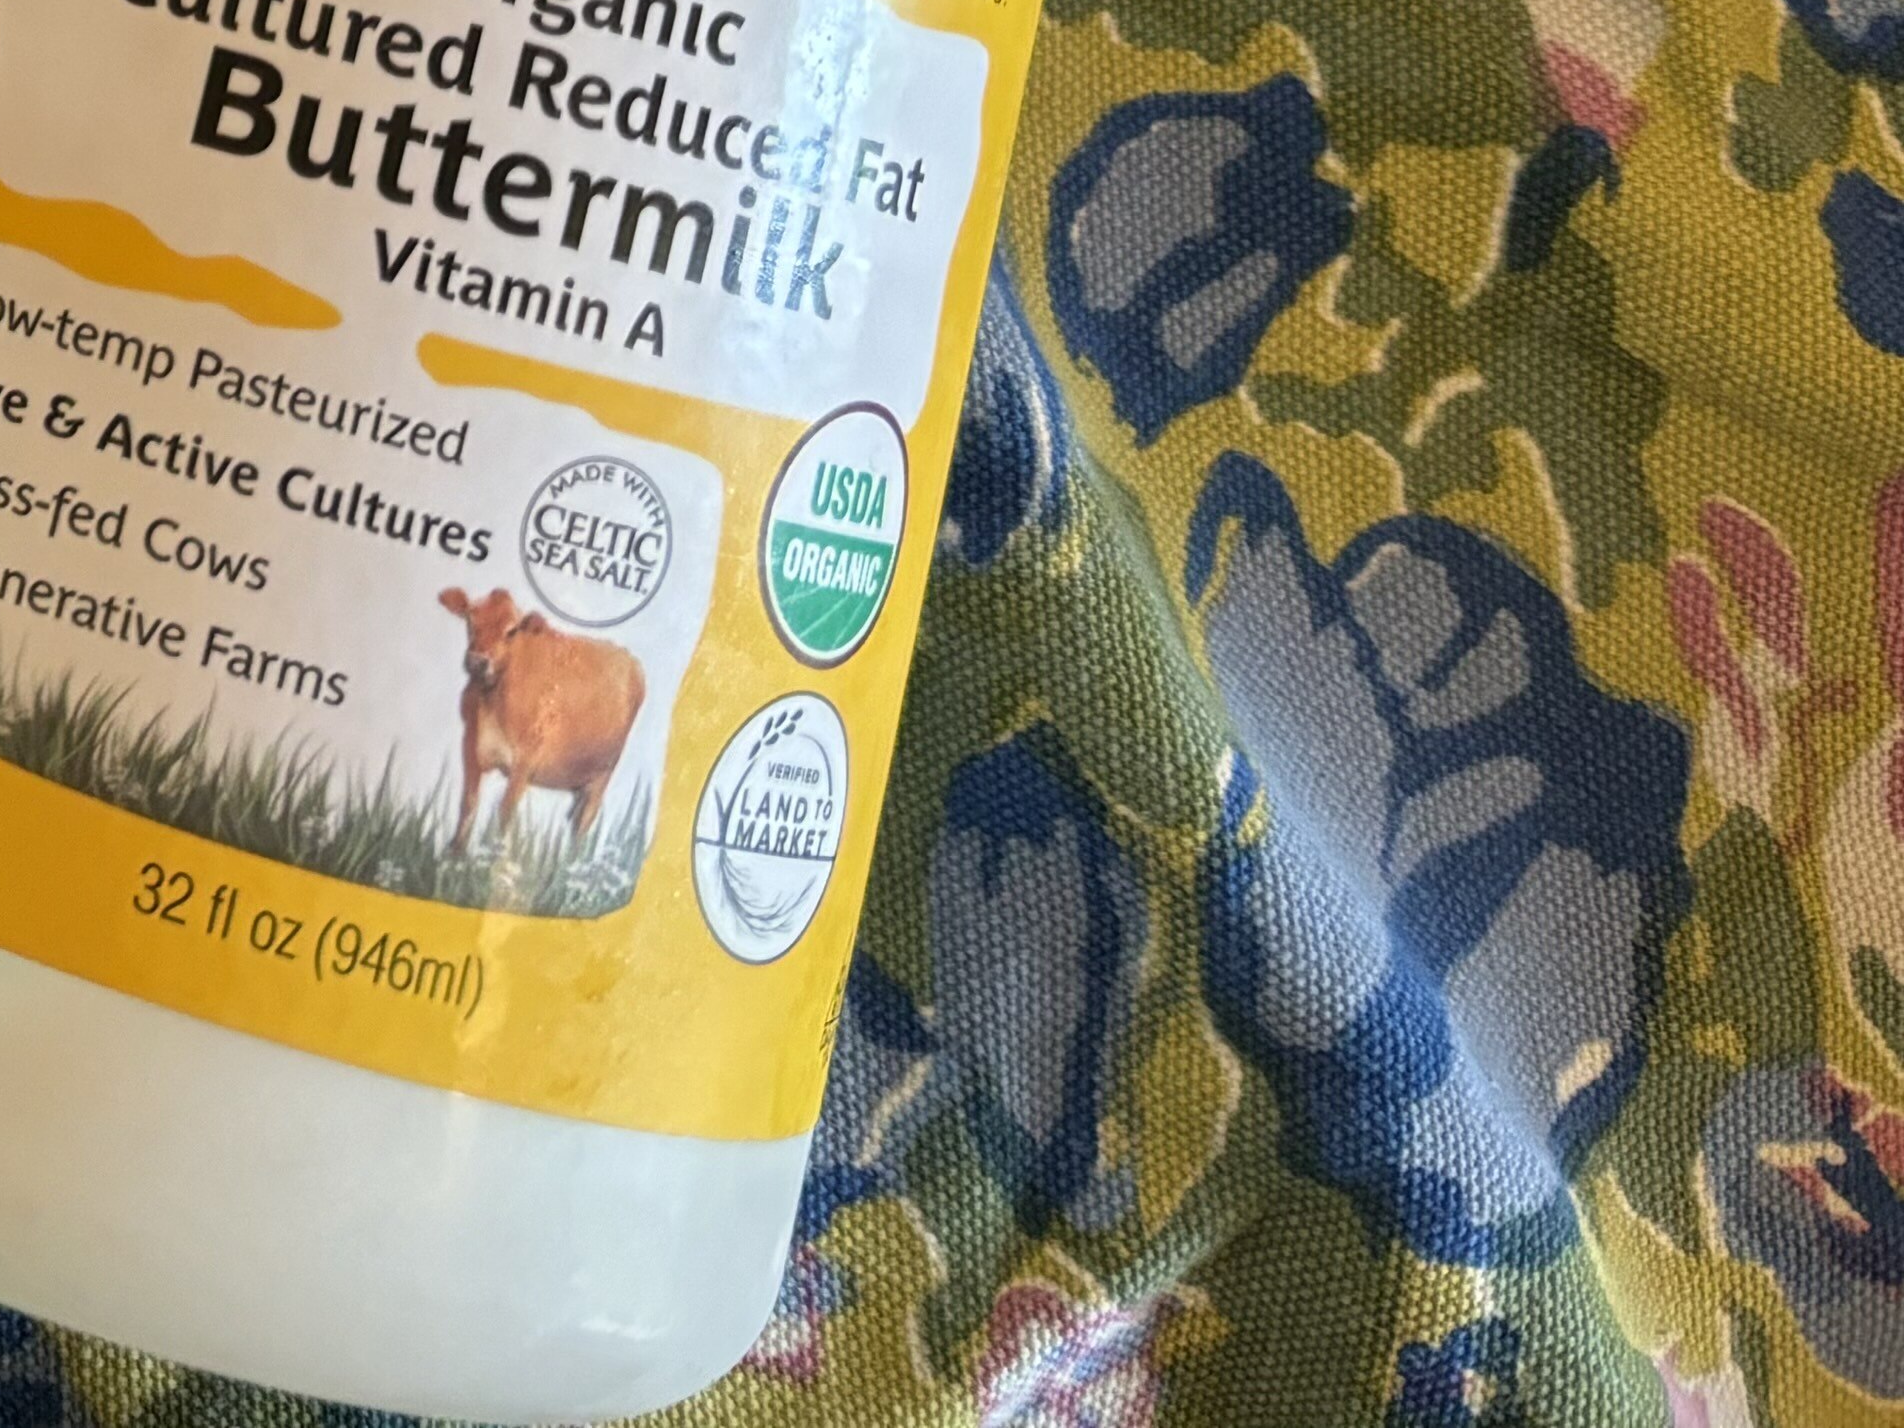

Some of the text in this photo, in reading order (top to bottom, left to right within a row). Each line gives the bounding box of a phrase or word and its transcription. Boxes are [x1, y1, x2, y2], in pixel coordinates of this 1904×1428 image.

[508, 39, 833, 184] Reduced
[843, 139, 927, 224] Fat
[190, 45, 847, 321] Buttermilk
[373, 228, 667, 359] Vitamin A
[190, 348, 469, 468] Pasteurized
[42, 393, 86, 440] &
[95, 414, 259, 498] Active
[277, 467, 494, 563] Cultures
[549, 463, 666, 529] MADE WITH
[810, 461, 887, 529] USDA
[142, 517, 272, 595] Cows
[526, 537, 579, 577] SEA
[533, 503, 663, 568] CELTIC
[782, 537, 882, 597] ORGANIC
[199, 630, 349, 709] Farms
[740, 788, 833, 824] LAND TO
[767, 761, 821, 785] VERIFIED
[733, 818, 828, 858] MARKET
[130, 860, 486, 1022] 32 fl oz (946ml)
